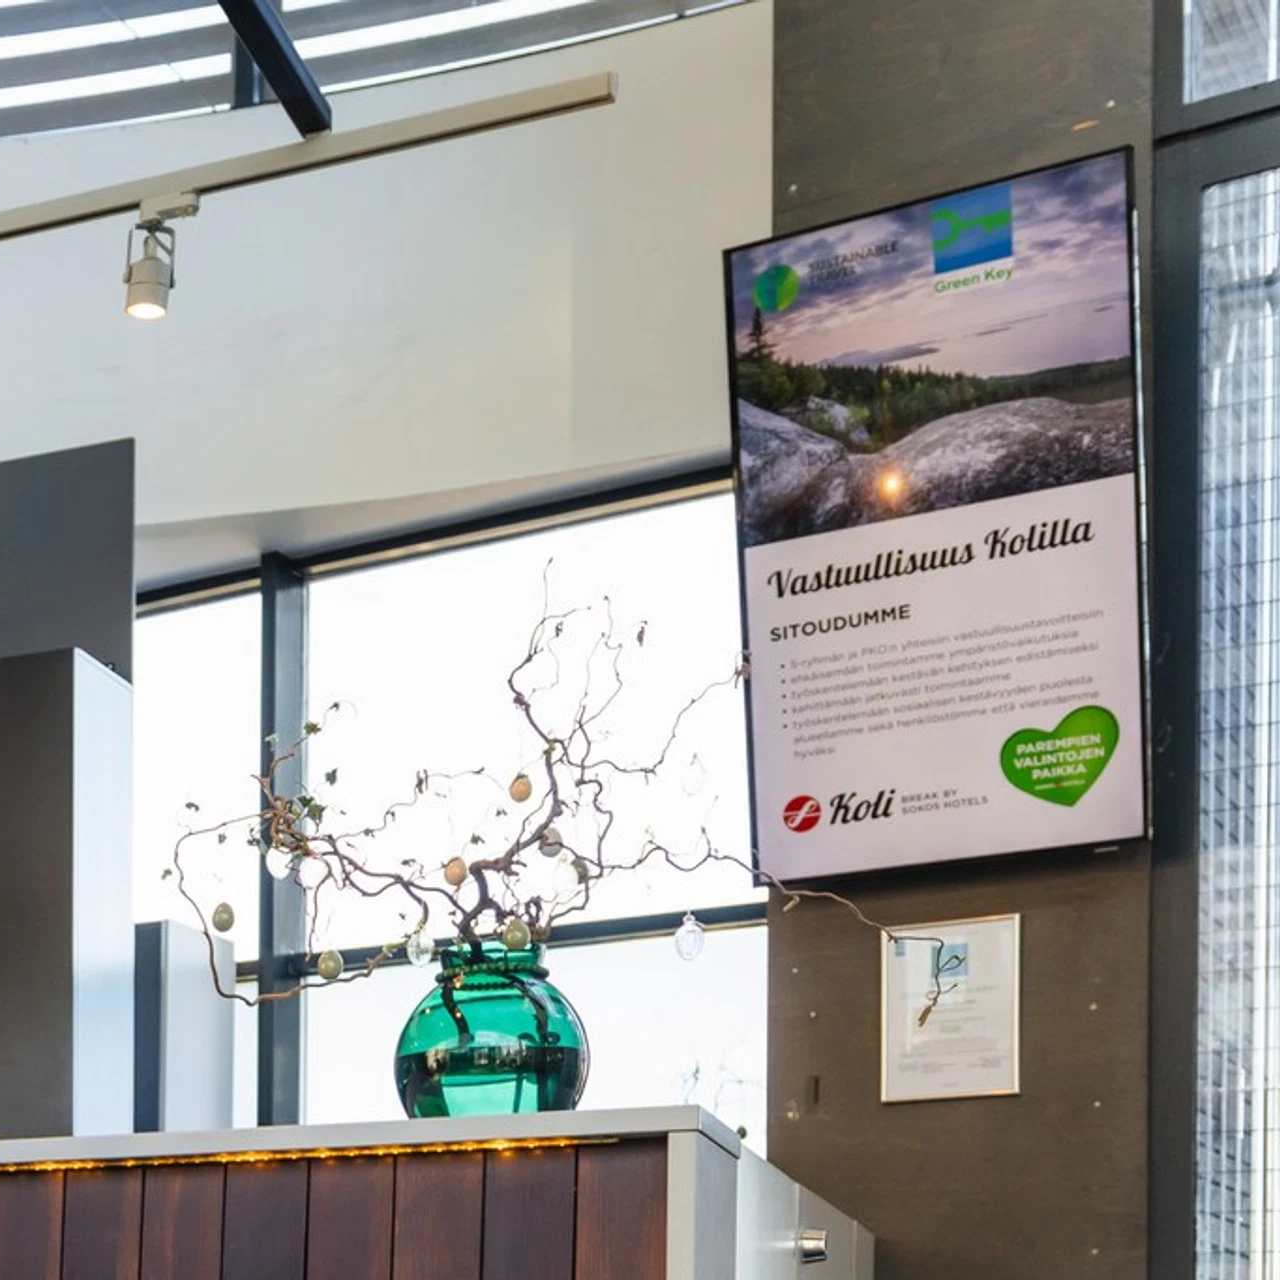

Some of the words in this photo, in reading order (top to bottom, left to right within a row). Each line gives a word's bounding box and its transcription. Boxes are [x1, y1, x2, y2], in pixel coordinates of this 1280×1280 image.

[934, 275, 980, 293] Green
[984, 267, 1013, 282] Key
[767, 543, 975, 599] Vastuullisuus
[983, 517, 1095, 561] Kolilla
[770, 603, 911, 642] SITOUDUMME
[1016, 733, 1101, 755] PAREMPIEN
[1013, 746, 1105, 769] VALINTOJEN
[1031, 762, 1087, 780] PAIKKA
[829, 788, 896, 826] Koli
[901, 791, 939, 804] BREAK
[943, 789, 958, 799] BY
[901, 801, 940, 815] SOKOS
[943, 795, 989, 809] HOTELS
